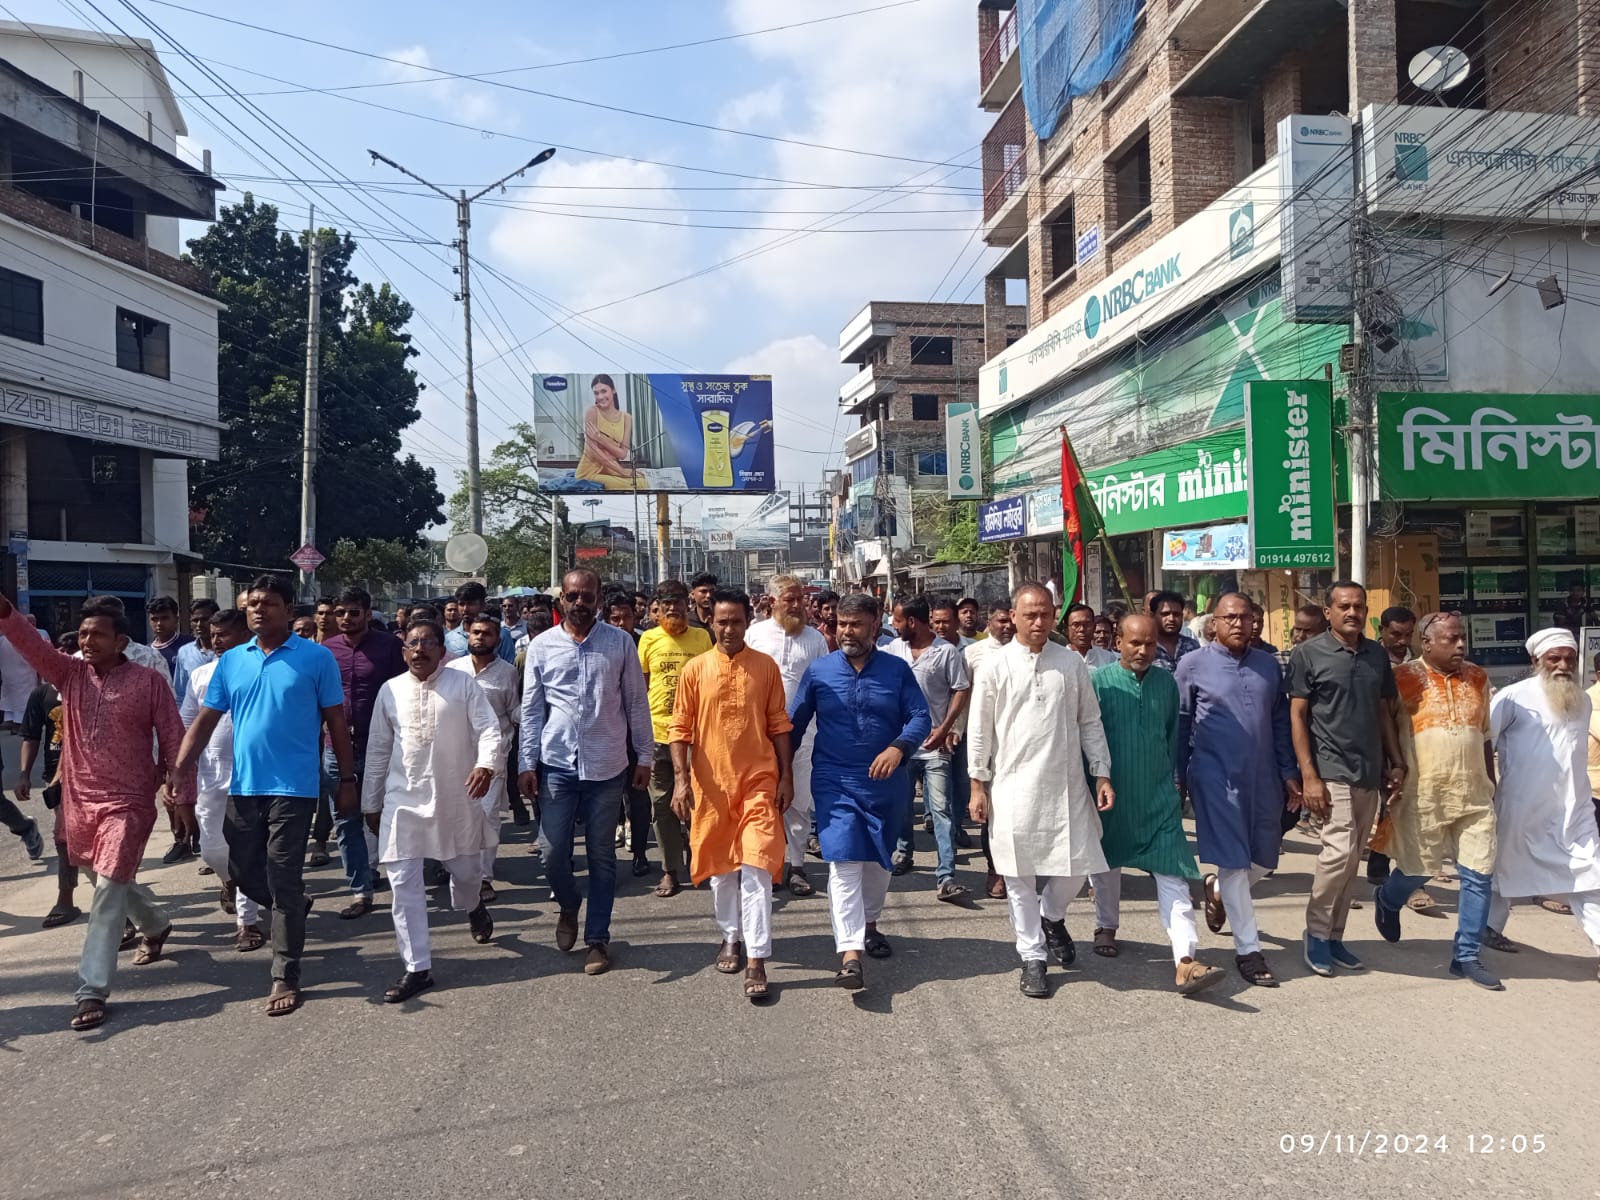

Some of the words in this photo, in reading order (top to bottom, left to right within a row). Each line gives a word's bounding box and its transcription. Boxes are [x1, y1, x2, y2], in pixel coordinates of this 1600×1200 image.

[1394, 132, 1425, 144] NRBC
[1102, 268, 1146, 324] NRBC
[1145, 252, 1182, 296] BANK
[1260, 278, 1282, 299] NRB
[0, 388, 52, 422] ZA
[961, 418, 970, 442] BANK
[959, 442, 971, 474] NRBC
[1278, 389, 1312, 541] minister
[1259, 554, 1291, 565] 01914
[1293, 552, 1331, 564] 497612
